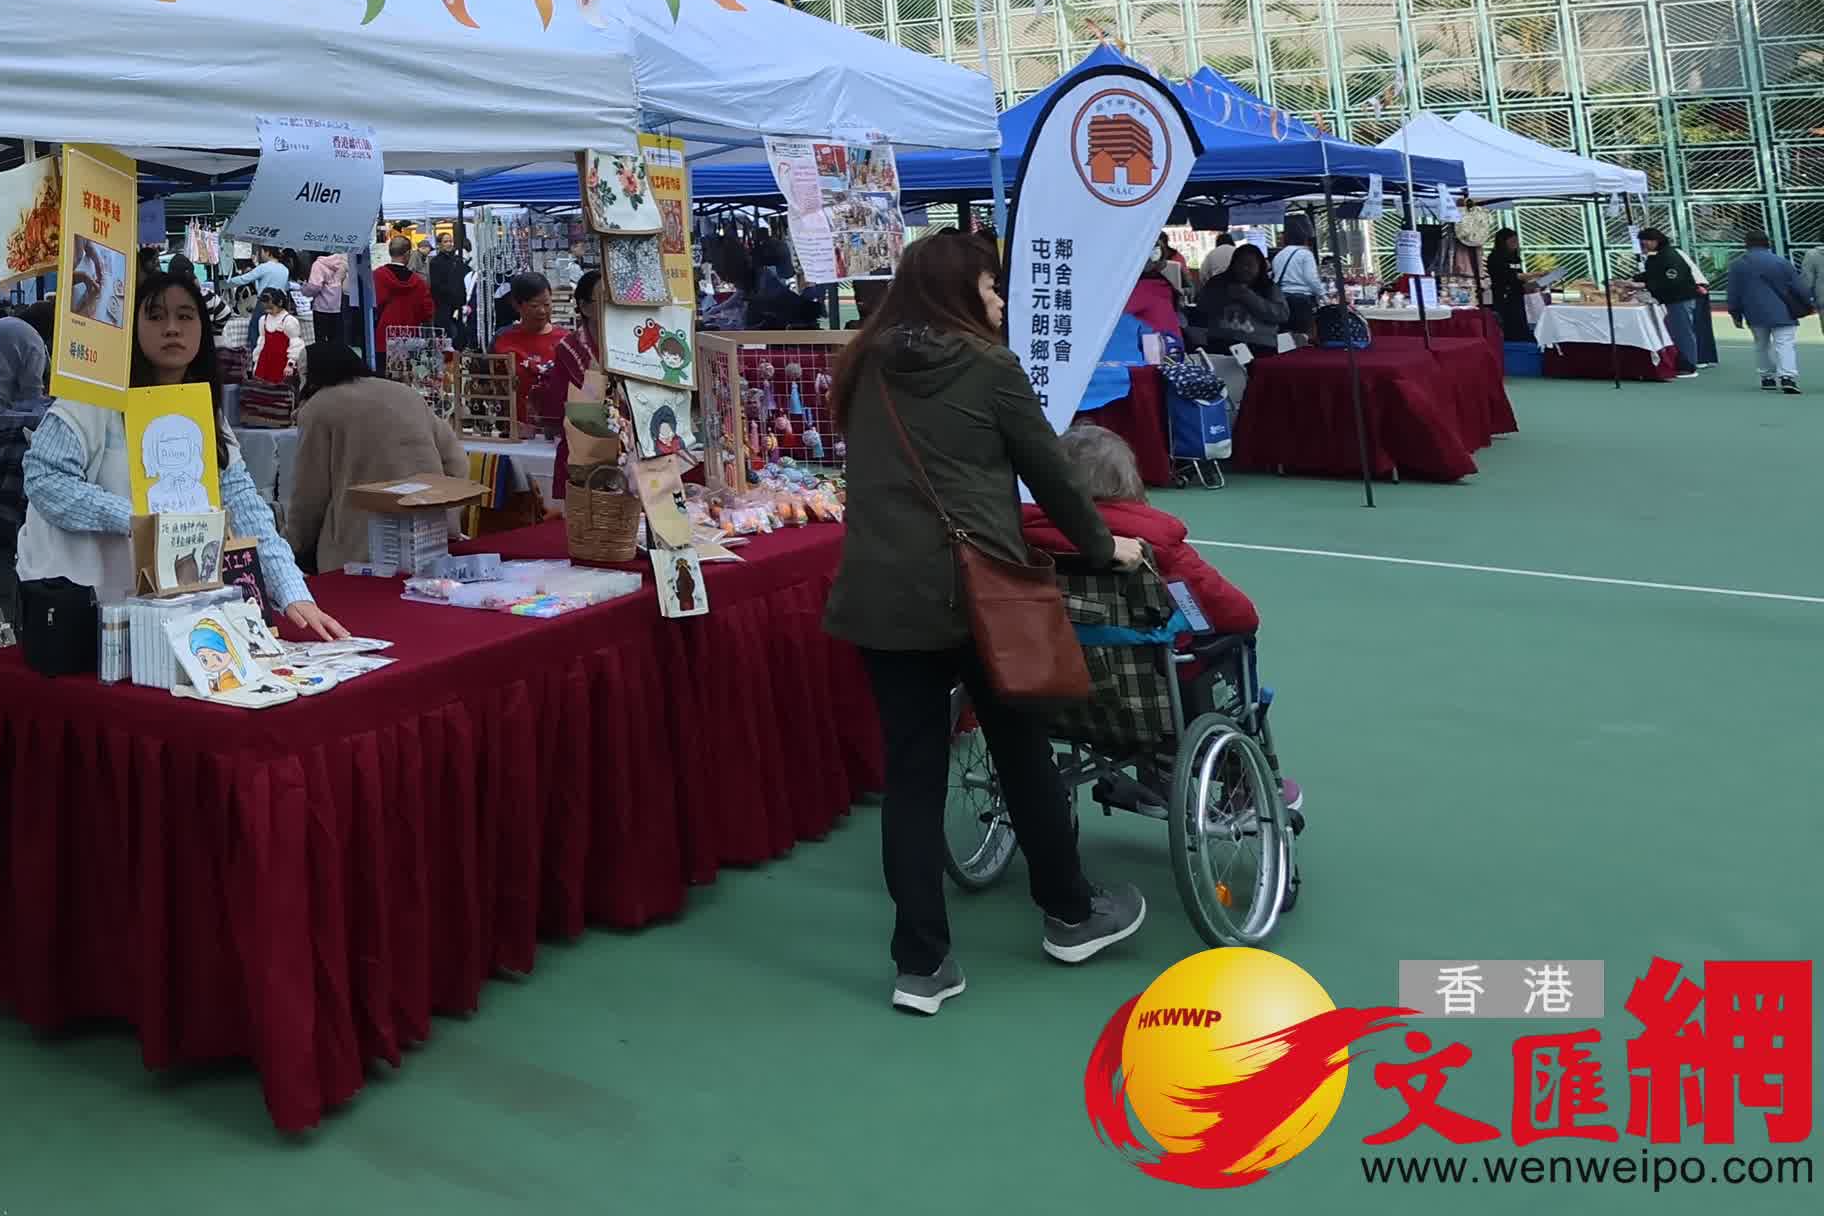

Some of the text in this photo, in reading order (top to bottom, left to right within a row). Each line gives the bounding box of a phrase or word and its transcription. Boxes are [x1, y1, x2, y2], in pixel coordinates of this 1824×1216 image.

[295, 181, 341, 204] Allen
[93, 216, 110, 239] DIY
[303, 232, 329, 242] Booth
[1053, 237, 1073, 363] 鄰舍輔導會
